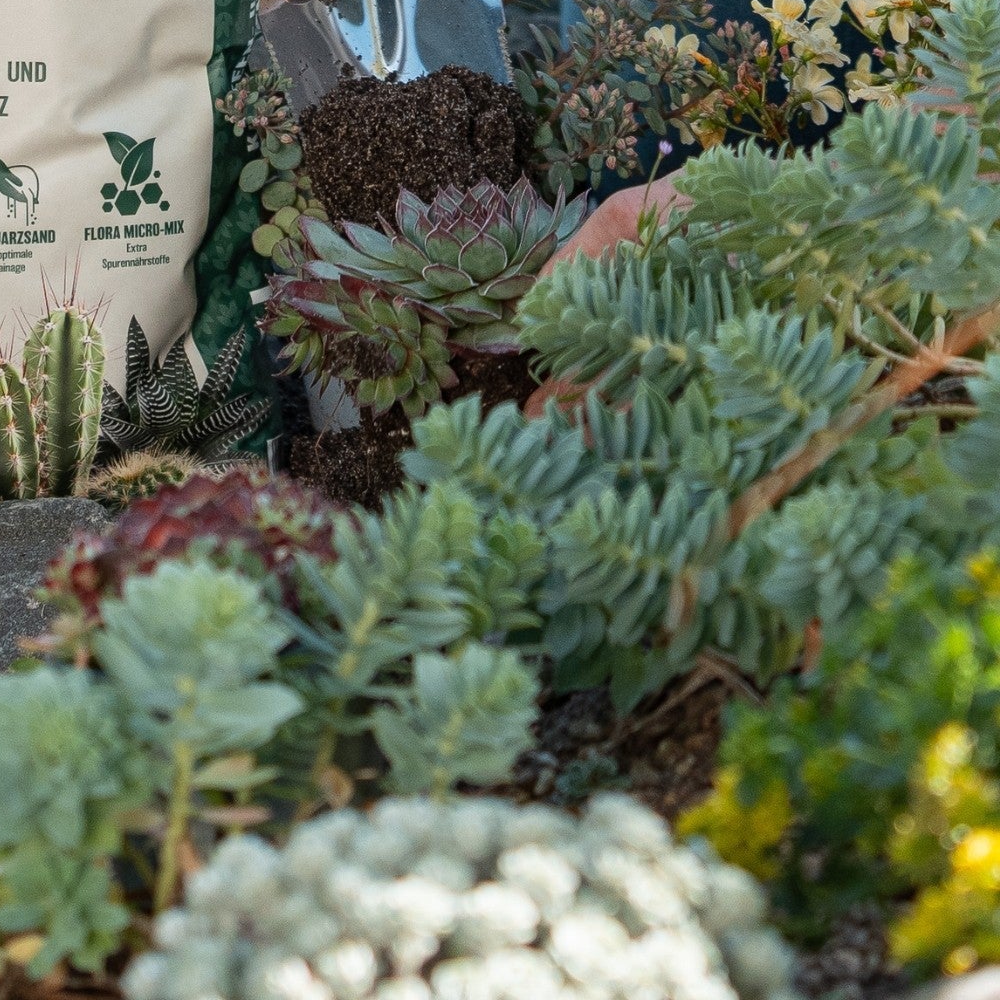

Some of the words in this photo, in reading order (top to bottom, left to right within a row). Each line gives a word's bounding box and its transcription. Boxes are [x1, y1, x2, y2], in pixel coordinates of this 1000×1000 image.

[7, 60, 48, 83] UND
[84, 225, 121, 242] FLORA
[123, 219, 185, 240] MICRO-MIX
[126, 243, 148, 254] Extra
[102, 254, 170, 271] Spurennährstoffe
